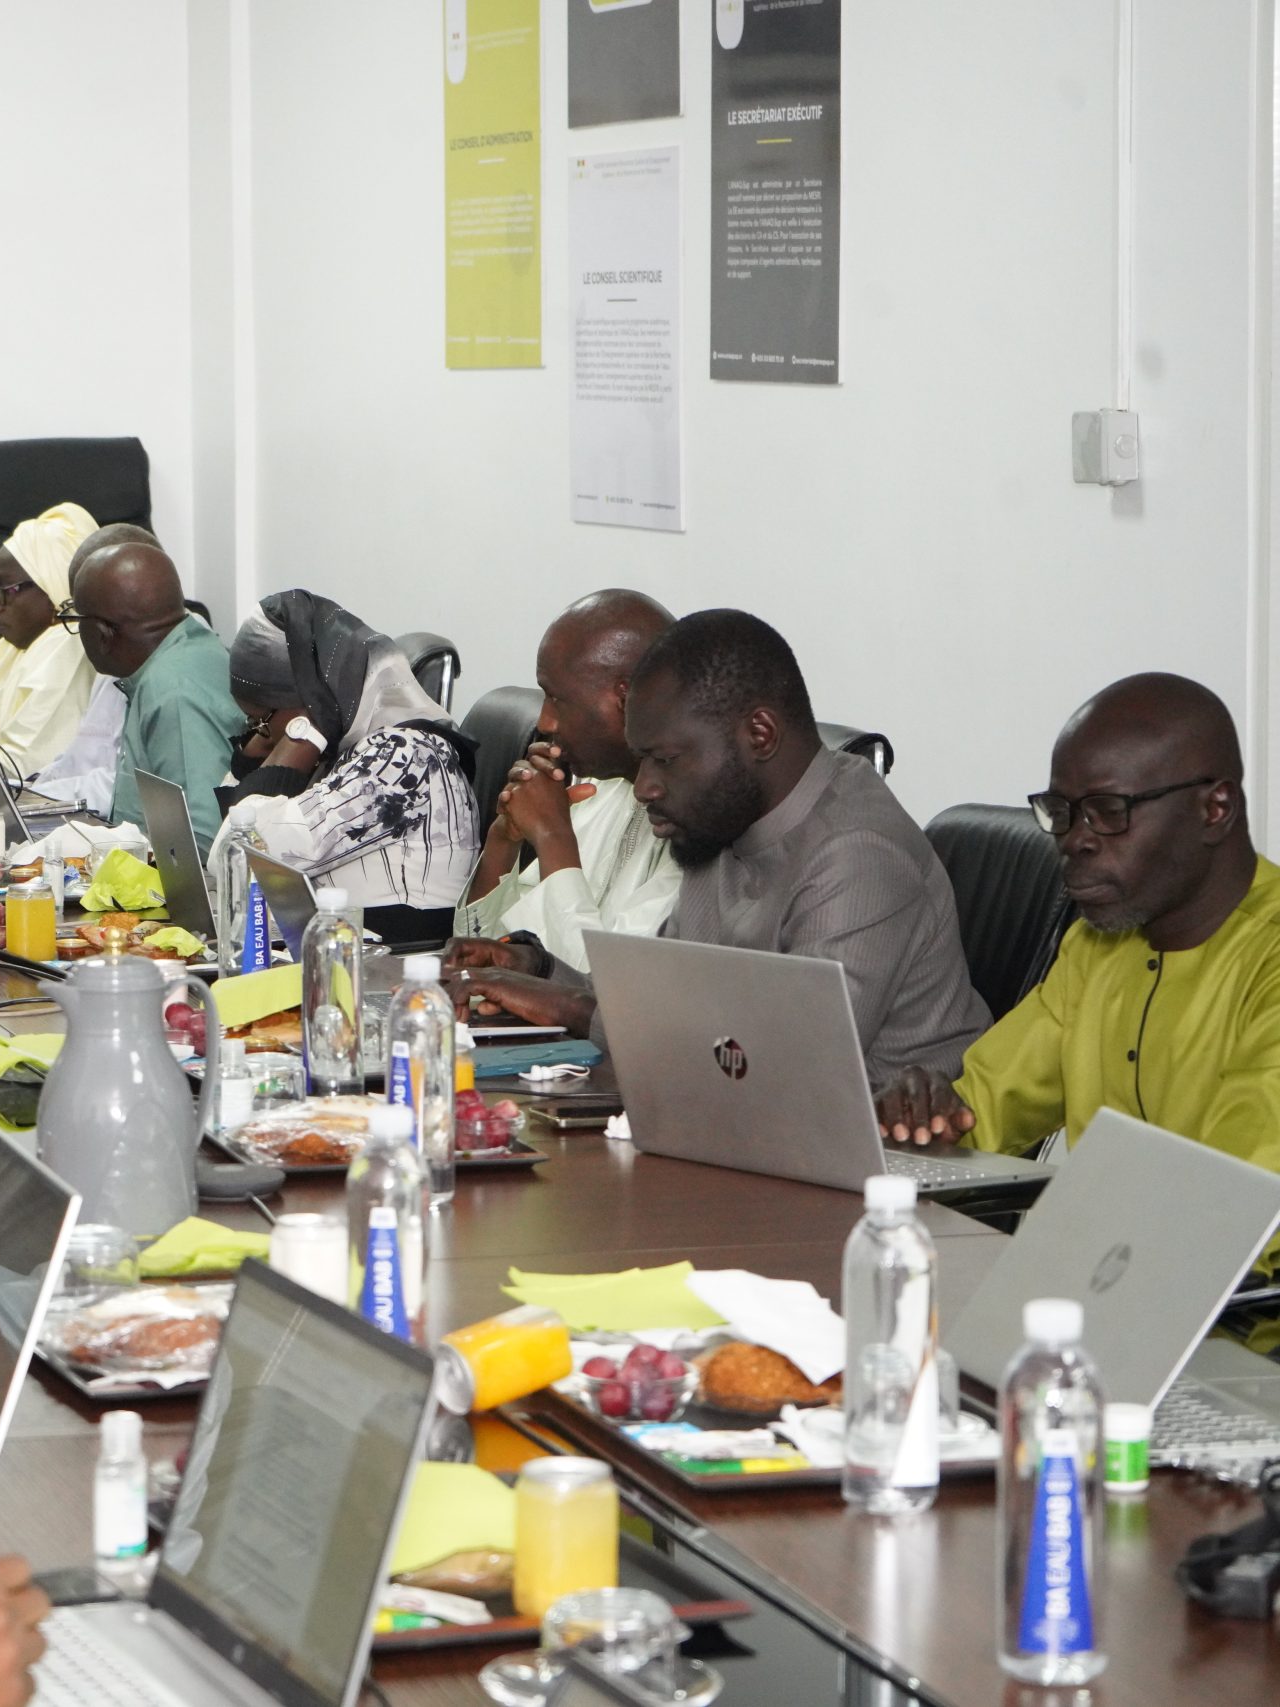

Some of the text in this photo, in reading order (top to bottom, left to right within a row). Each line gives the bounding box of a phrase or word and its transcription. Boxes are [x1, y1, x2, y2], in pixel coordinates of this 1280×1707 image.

[728, 102, 823, 126] LE SECRÉTARIAT EXÉCUTIF
[583, 270, 662, 285] LE CONSEIL SCIENTIFIQUE
[254, 904, 265, 965] BA EAU BAB
[719, 1037, 743, 1080] hp
[393, 1085, 407, 1105] AB
[1045, 1541, 1071, 1587] EAU
[1045, 1586, 1071, 1620] BA
